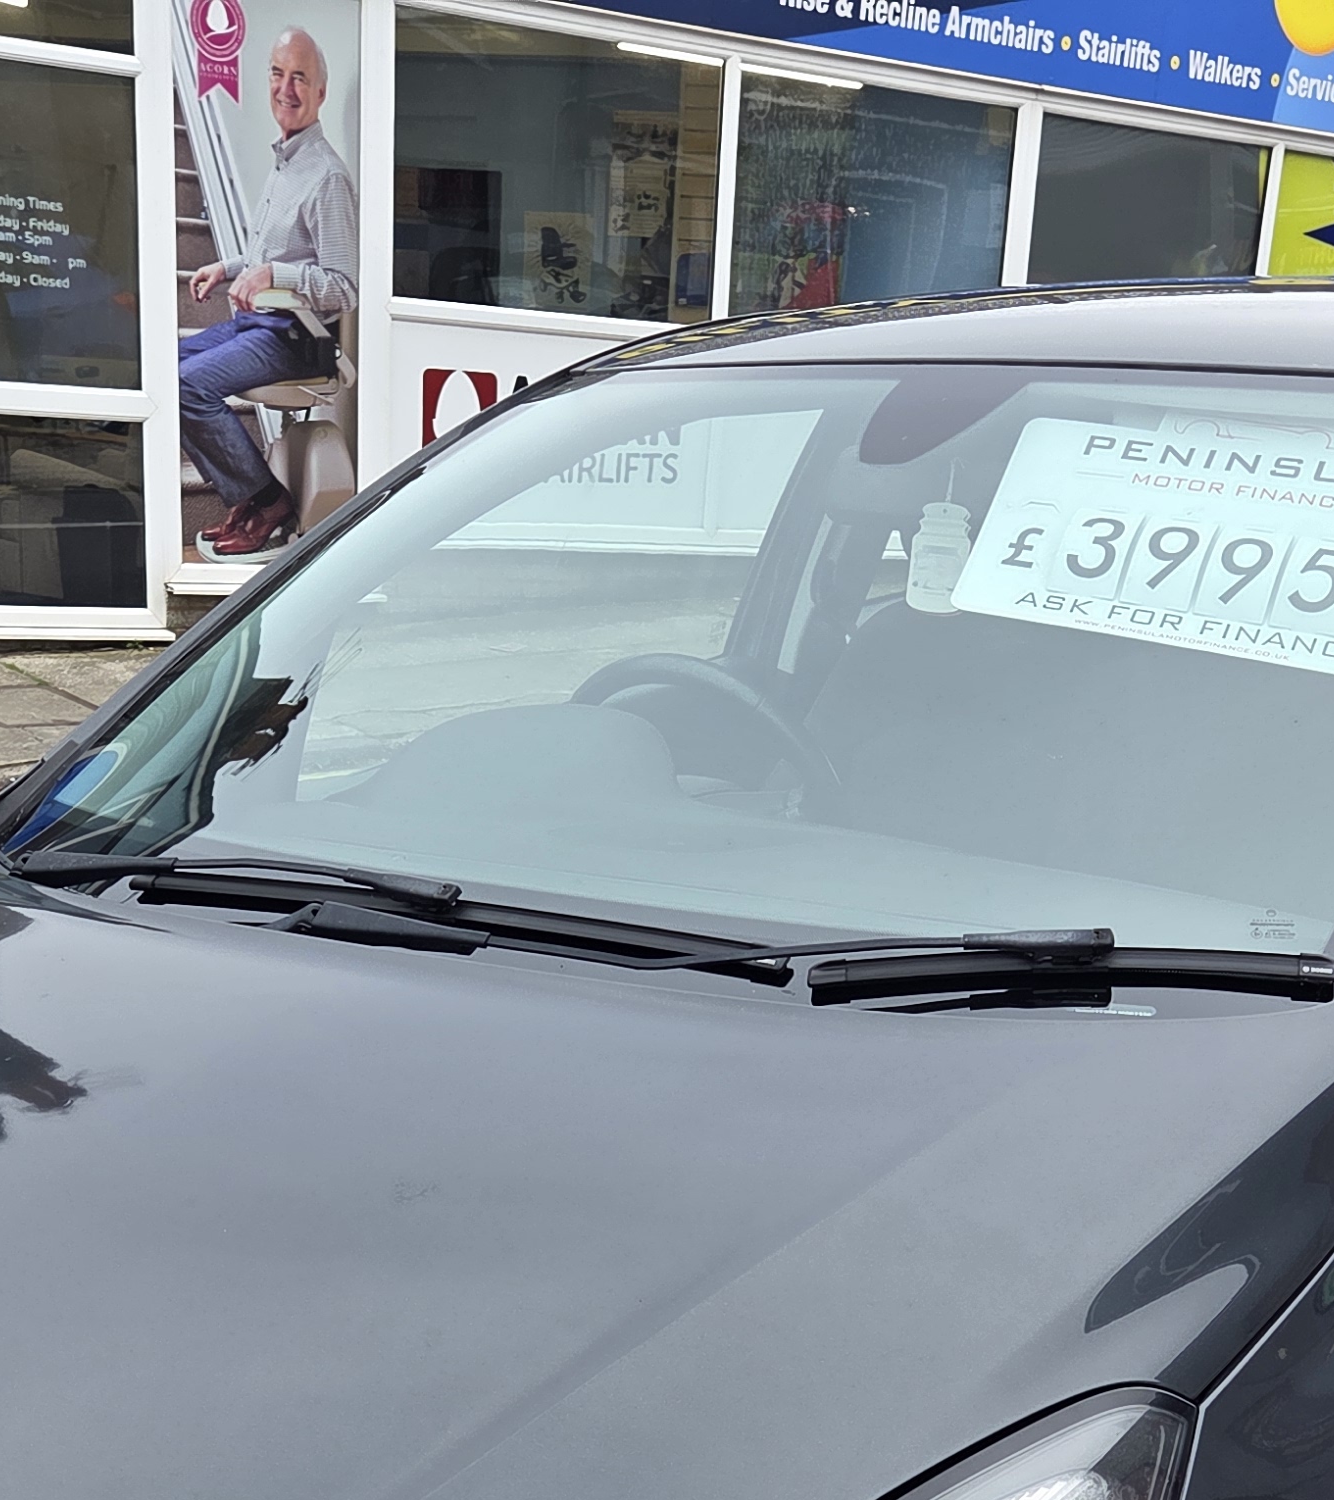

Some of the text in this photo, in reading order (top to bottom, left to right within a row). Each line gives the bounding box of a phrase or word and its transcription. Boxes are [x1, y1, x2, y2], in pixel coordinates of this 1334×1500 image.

[779, 0, 827, 14] se
[835, 0, 853, 18] &
[859, 0, 940, 34] Recline
[944, 6, 1055, 54] Armchairs
[1077, 29, 1161, 73] Stairlifts
[1188, 49, 1262, 90] Walkers
[200, 62, 238, 76] ACORN
[26, 196, 64, 212] Times
[28, 218, 70, 236] Friday
[24, 231, 53, 247] 5pm
[22, 251, 51, 265] 9am
[67, 258, 87, 270] pm
[29, 274, 70, 288] Closed
[542, 452, 679, 484] IRLIFTS
[1131, 473, 1224, 495] MOTOR
[1000, 527, 1045, 569] £
[1015, 592, 1094, 615] ASK
[1107, 604, 1184, 631] FOR
